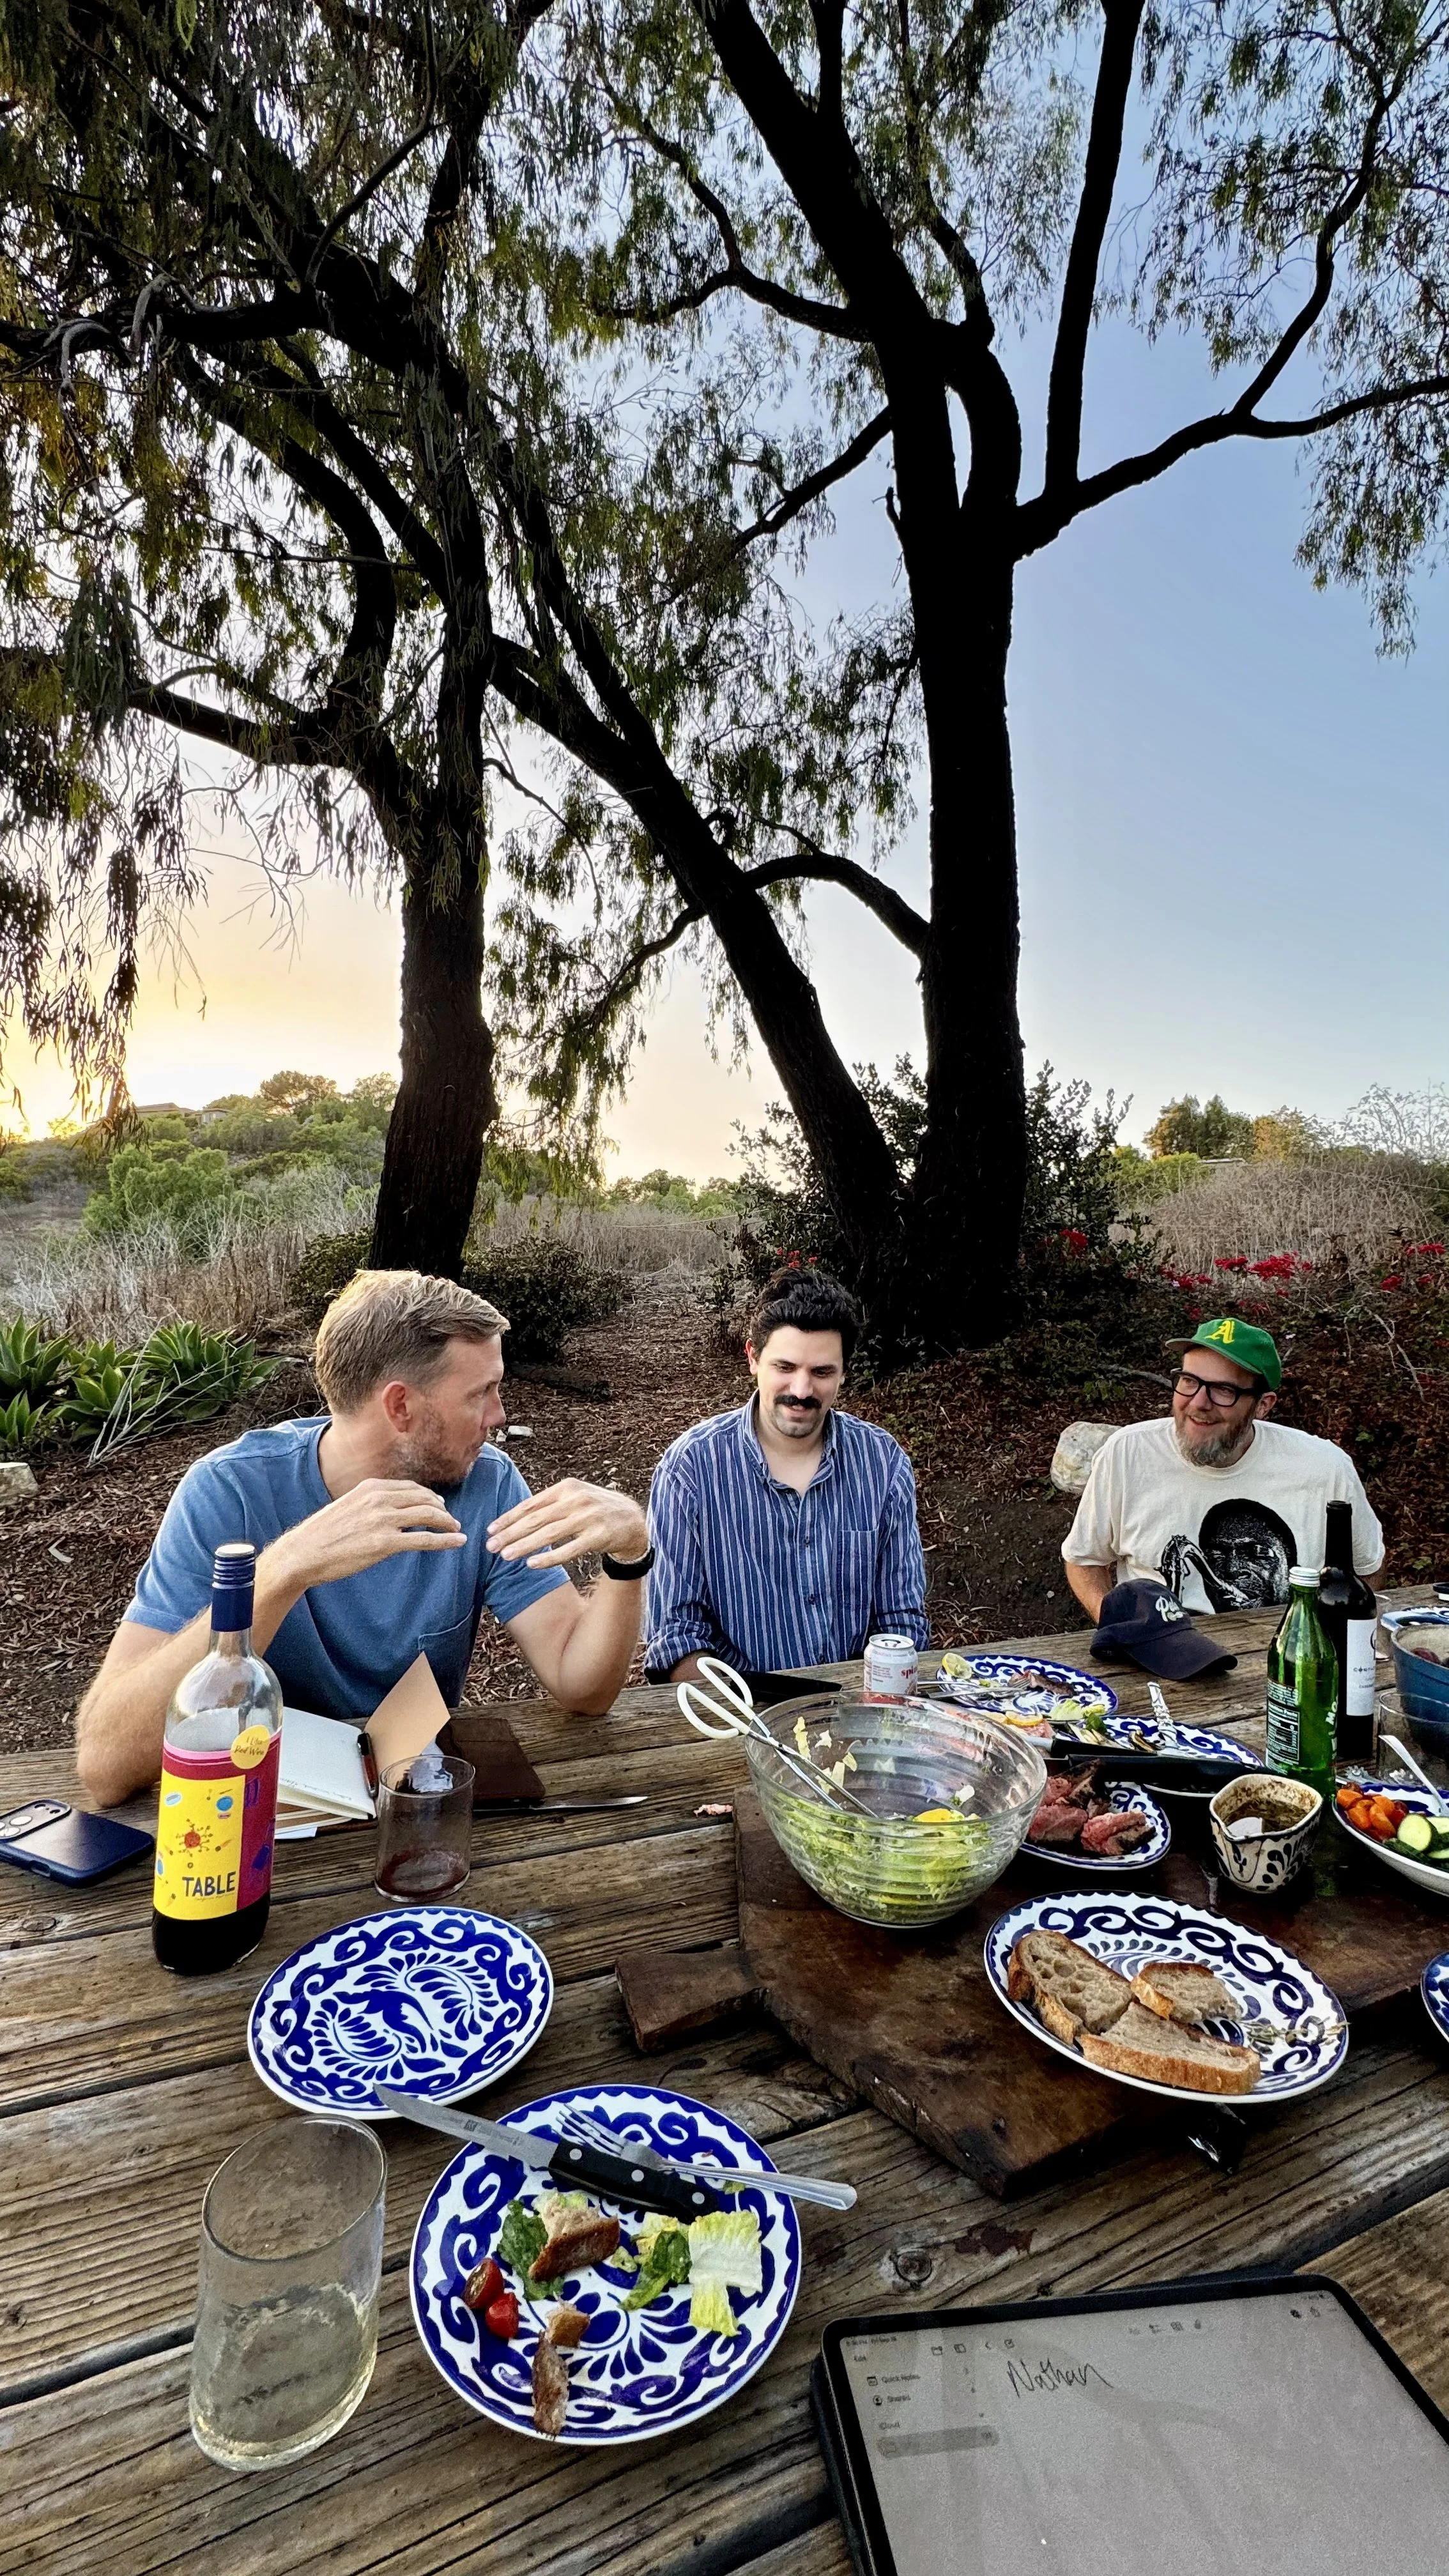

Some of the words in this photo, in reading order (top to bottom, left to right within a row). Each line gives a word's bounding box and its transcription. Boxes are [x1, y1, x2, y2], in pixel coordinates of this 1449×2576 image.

[1204, 1320, 1235, 1344] A
[182, 1871, 236, 1897] TABLE
[1006, 2358, 1114, 2398] Nathan
